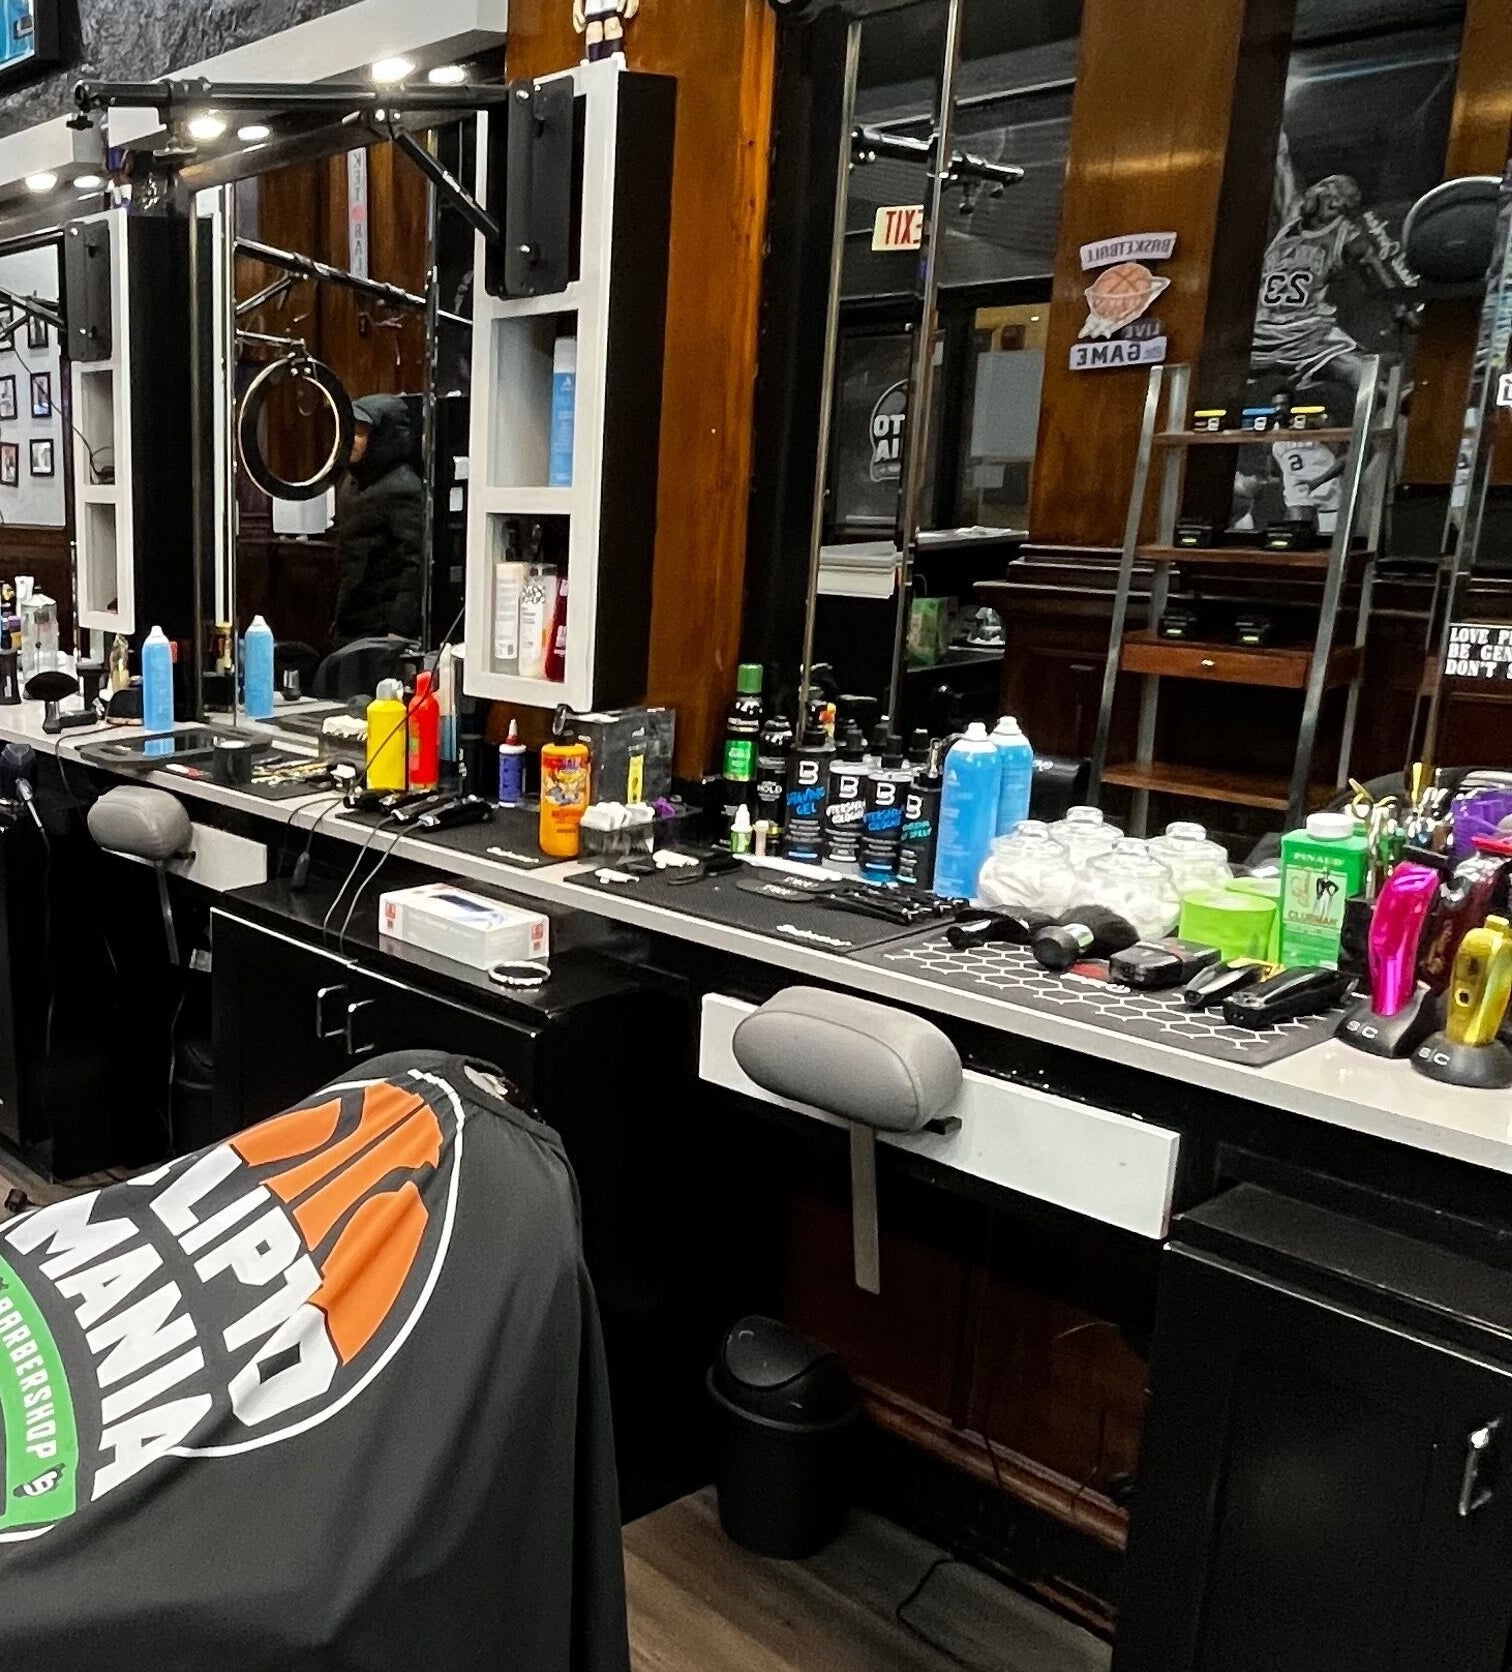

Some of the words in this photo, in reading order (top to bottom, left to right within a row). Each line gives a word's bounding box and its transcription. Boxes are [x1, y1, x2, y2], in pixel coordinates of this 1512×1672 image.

[1449, 627, 1489, 645] LOVE
[1448, 643, 1471, 660] BE
[1444, 659, 1497, 679] DON'T
[796, 801, 817, 815] GEL
[1293, 852, 1345, 866] PINAUD
[126, 1143, 339, 1427] LIPTO
[4, 1189, 214, 1502] MANIA
